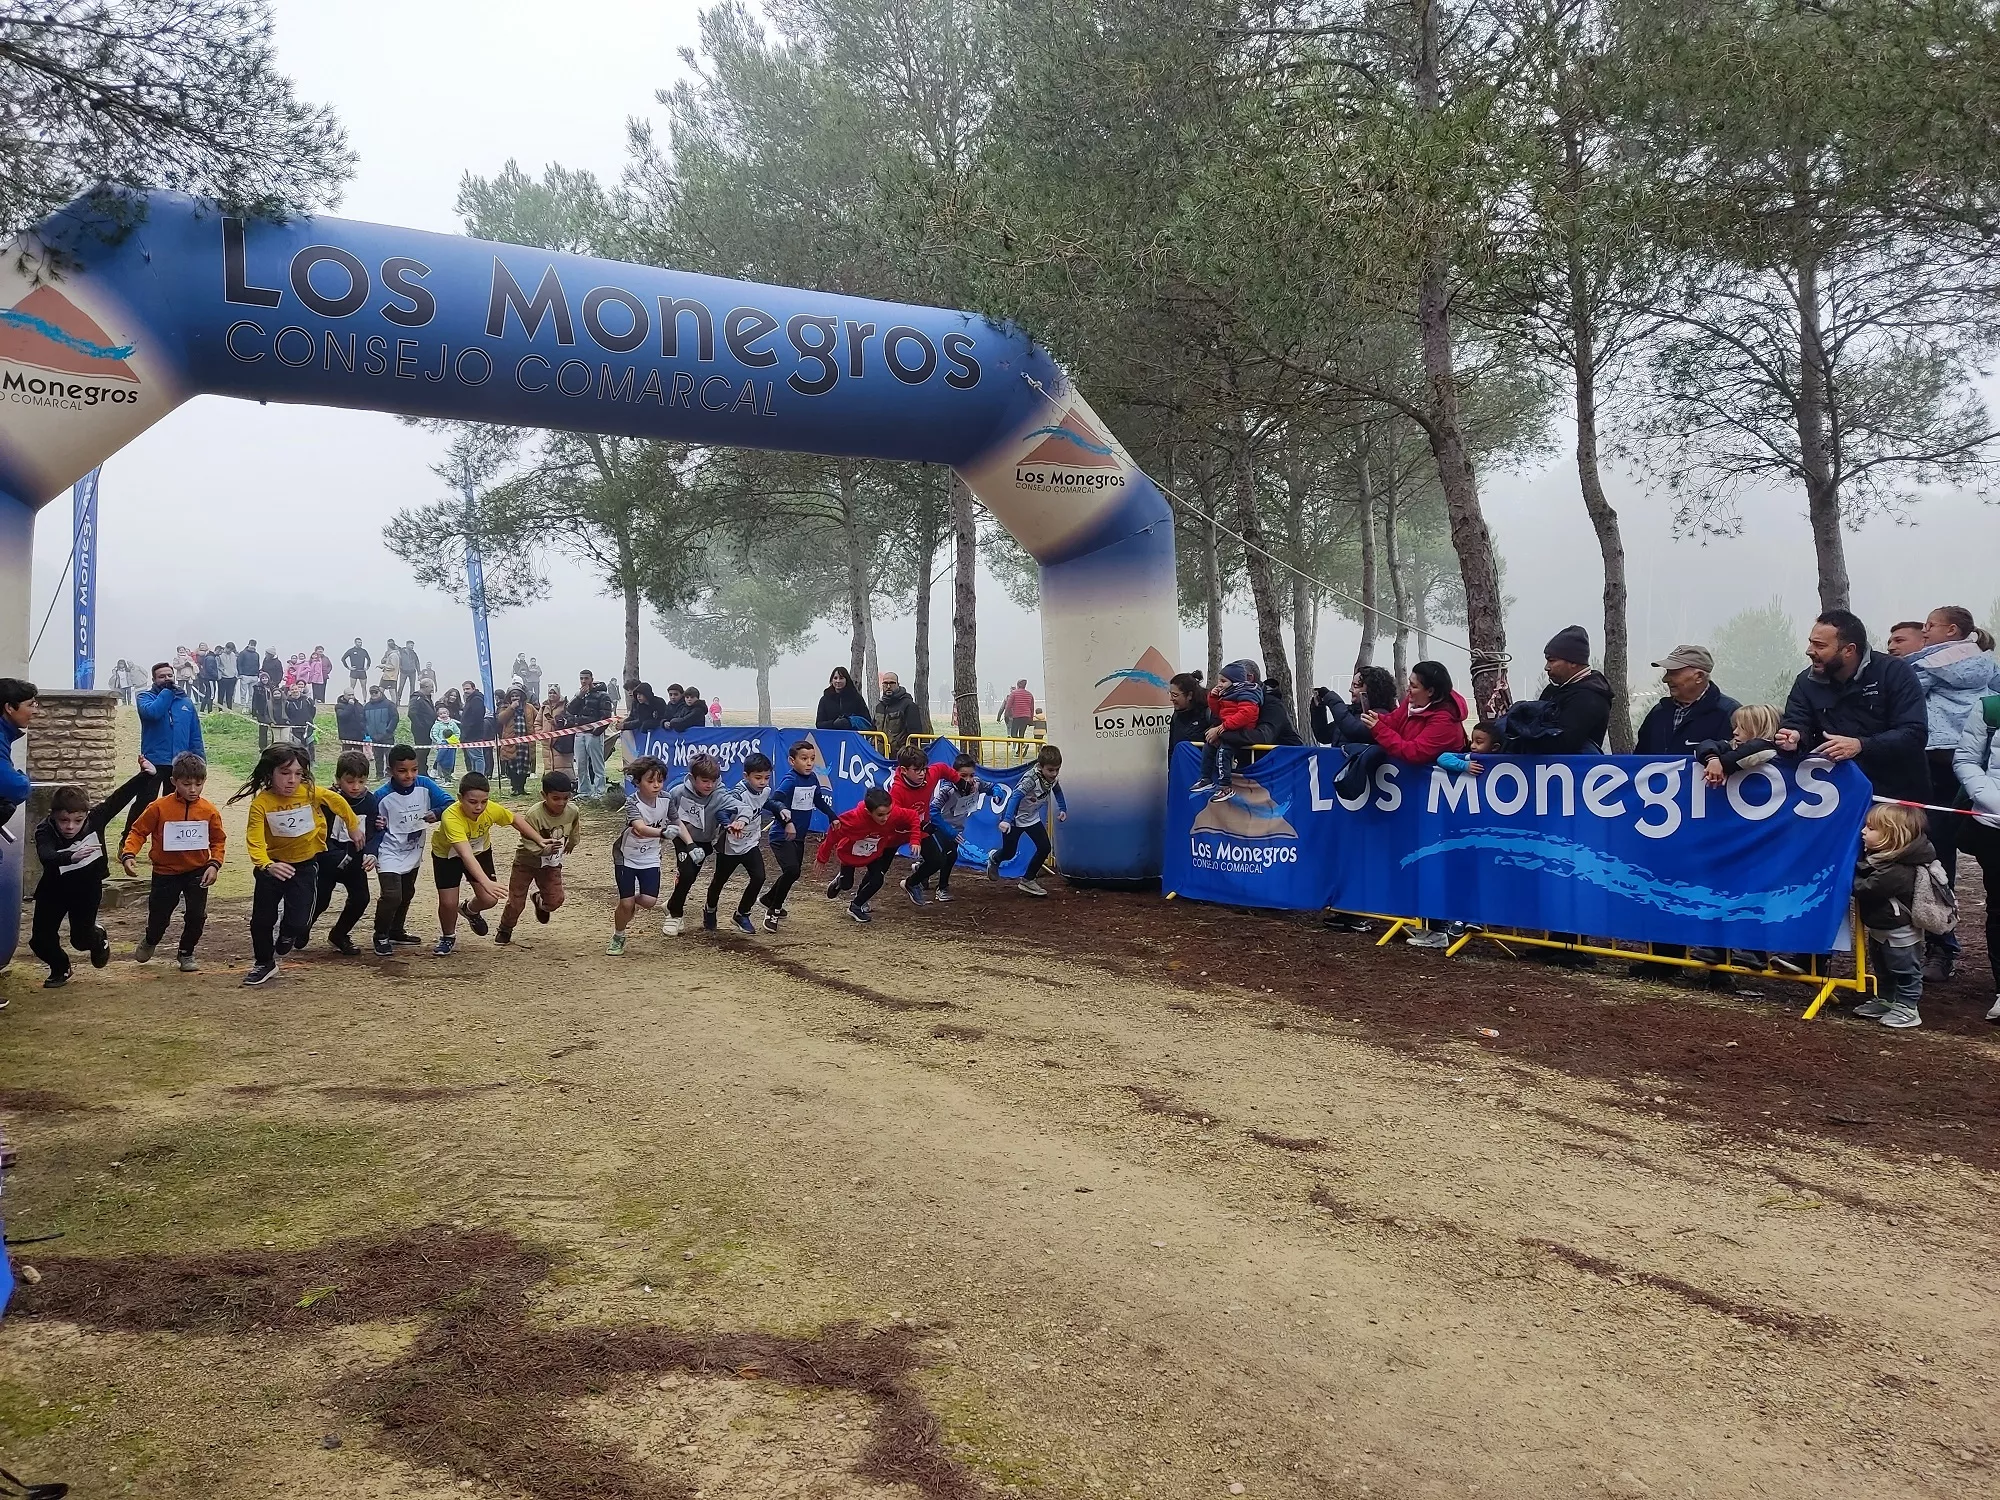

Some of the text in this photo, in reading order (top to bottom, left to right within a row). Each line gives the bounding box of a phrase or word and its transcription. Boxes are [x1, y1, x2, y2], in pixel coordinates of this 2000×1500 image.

[221, 217, 982, 397] Los Monegros
[225, 319, 778, 417] CONSEJO COMARCAL
[2, 370, 139, 406] Monegros
[11, 392, 83, 411] COMARCAL
[1015, 468, 1125, 489] Los Monegros
[1015, 482, 1095, 494] CONSEJO COMARCAL
[1094, 713, 1172, 730] Los Mone
[1096, 726, 1170, 739] CONSEJO COMARC
[287, 817, 297, 828] 2
[180, 828, 198, 838] 102
[1191, 837, 1298, 868] Los Monegros
[1220, 861, 1263, 874] COMARCAL
